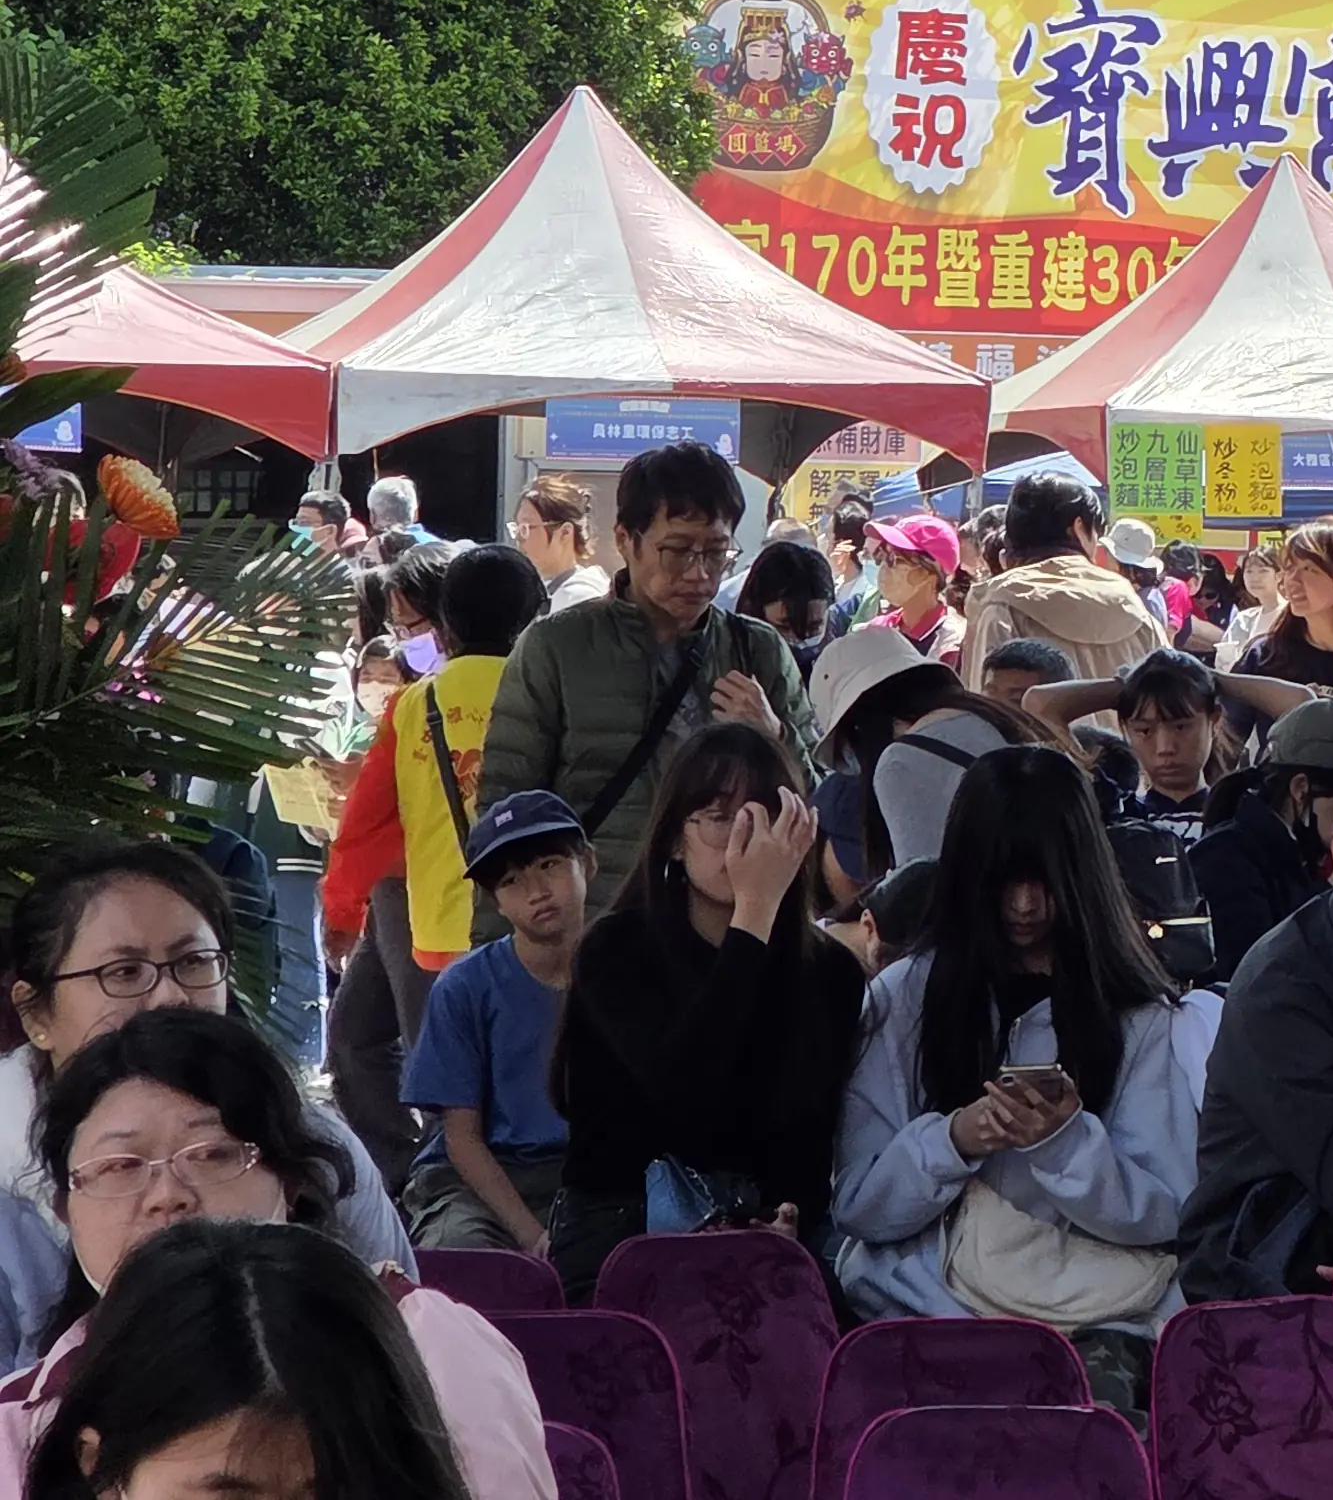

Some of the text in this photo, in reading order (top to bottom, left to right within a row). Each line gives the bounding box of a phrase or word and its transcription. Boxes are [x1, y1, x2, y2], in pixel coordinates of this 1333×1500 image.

[894, 8, 968, 168] 慶祝
[1113, 429, 1140, 508] 炒泡麵
[1142, 429, 1169, 509] 九層糕
[1171, 430, 1198, 510] 仙草凍
[1213, 437, 1238, 501] 炒冬粉
